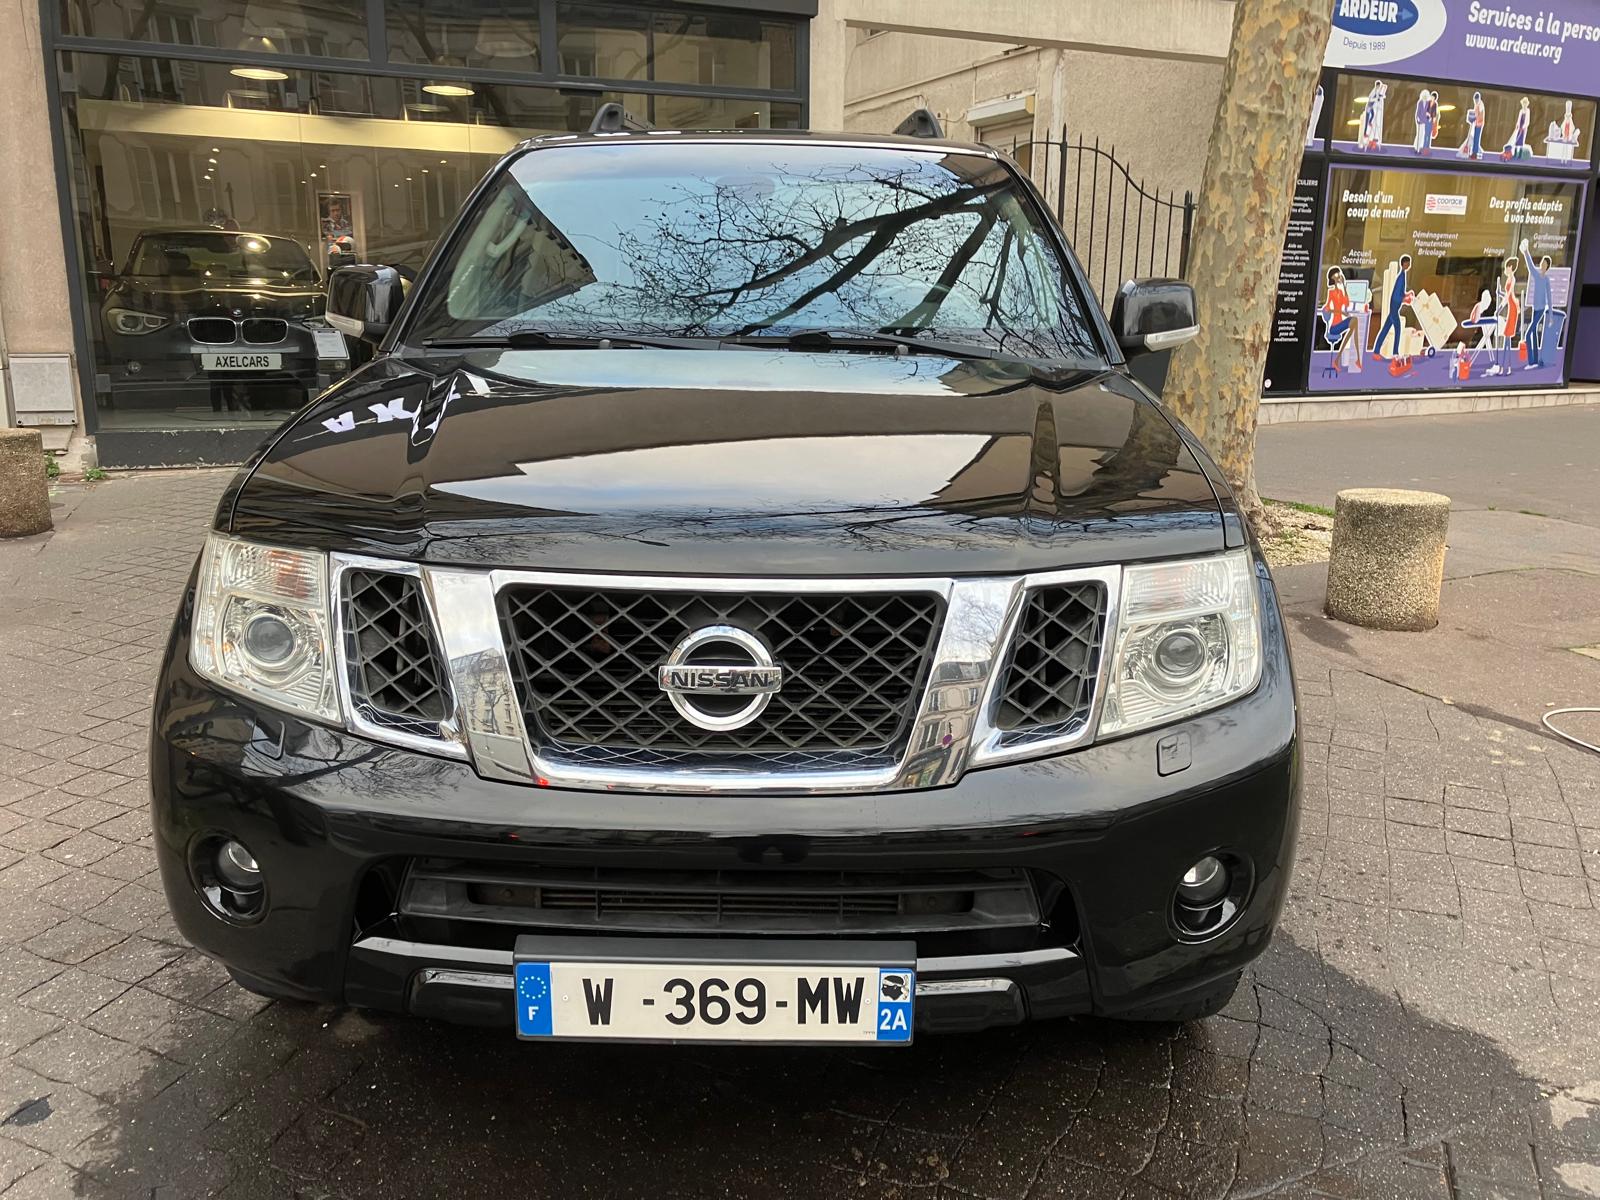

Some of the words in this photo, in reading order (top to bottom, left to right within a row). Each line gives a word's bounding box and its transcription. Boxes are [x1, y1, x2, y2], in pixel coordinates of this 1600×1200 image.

[1339, 0, 1399, 23] ARDEUR
[1468, 1, 1532, 31] Services
[1534, 11, 1544, 32] à
[1546, 12, 1561, 35] la
[1561, 21, 1600, 43] perso
[1343, 37, 1367, 50] Depuis
[1369, 42, 1386, 50] 1989
[1465, 33, 1562, 64] www.ardeur.org
[1342, 189, 1372, 203] Besoin
[1373, 191, 1394, 204] d'un
[1347, 207, 1369, 221] coup
[1370, 205, 1381, 216] de
[1382, 206, 1410, 219] main?
[1489, 196, 1505, 209] Des
[1505, 197, 1531, 213] profils
[1532, 198, 1563, 215] adaptés
[1504, 211, 1510, 223] à
[1511, 214, 1524, 223] vos
[1525, 211, 1554, 224] besoins
[1412, 230, 1458, 240] Déménagement
[1414, 239, 1452, 248] Manutention
[1348, 249, 1372, 257] Accueil
[1418, 248, 1446, 258] Bricolage
[1483, 247, 1505, 257] Ménage
[1341, 256, 1377, 265] Secrétariat
[215, 356, 270, 368] AXELCARS
[671, 671, 769, 688] NISSAN
[582, 978, 614, 1025] W
[527, 1006, 539, 1021] F
[879, 1008, 907, 1031] 2A
